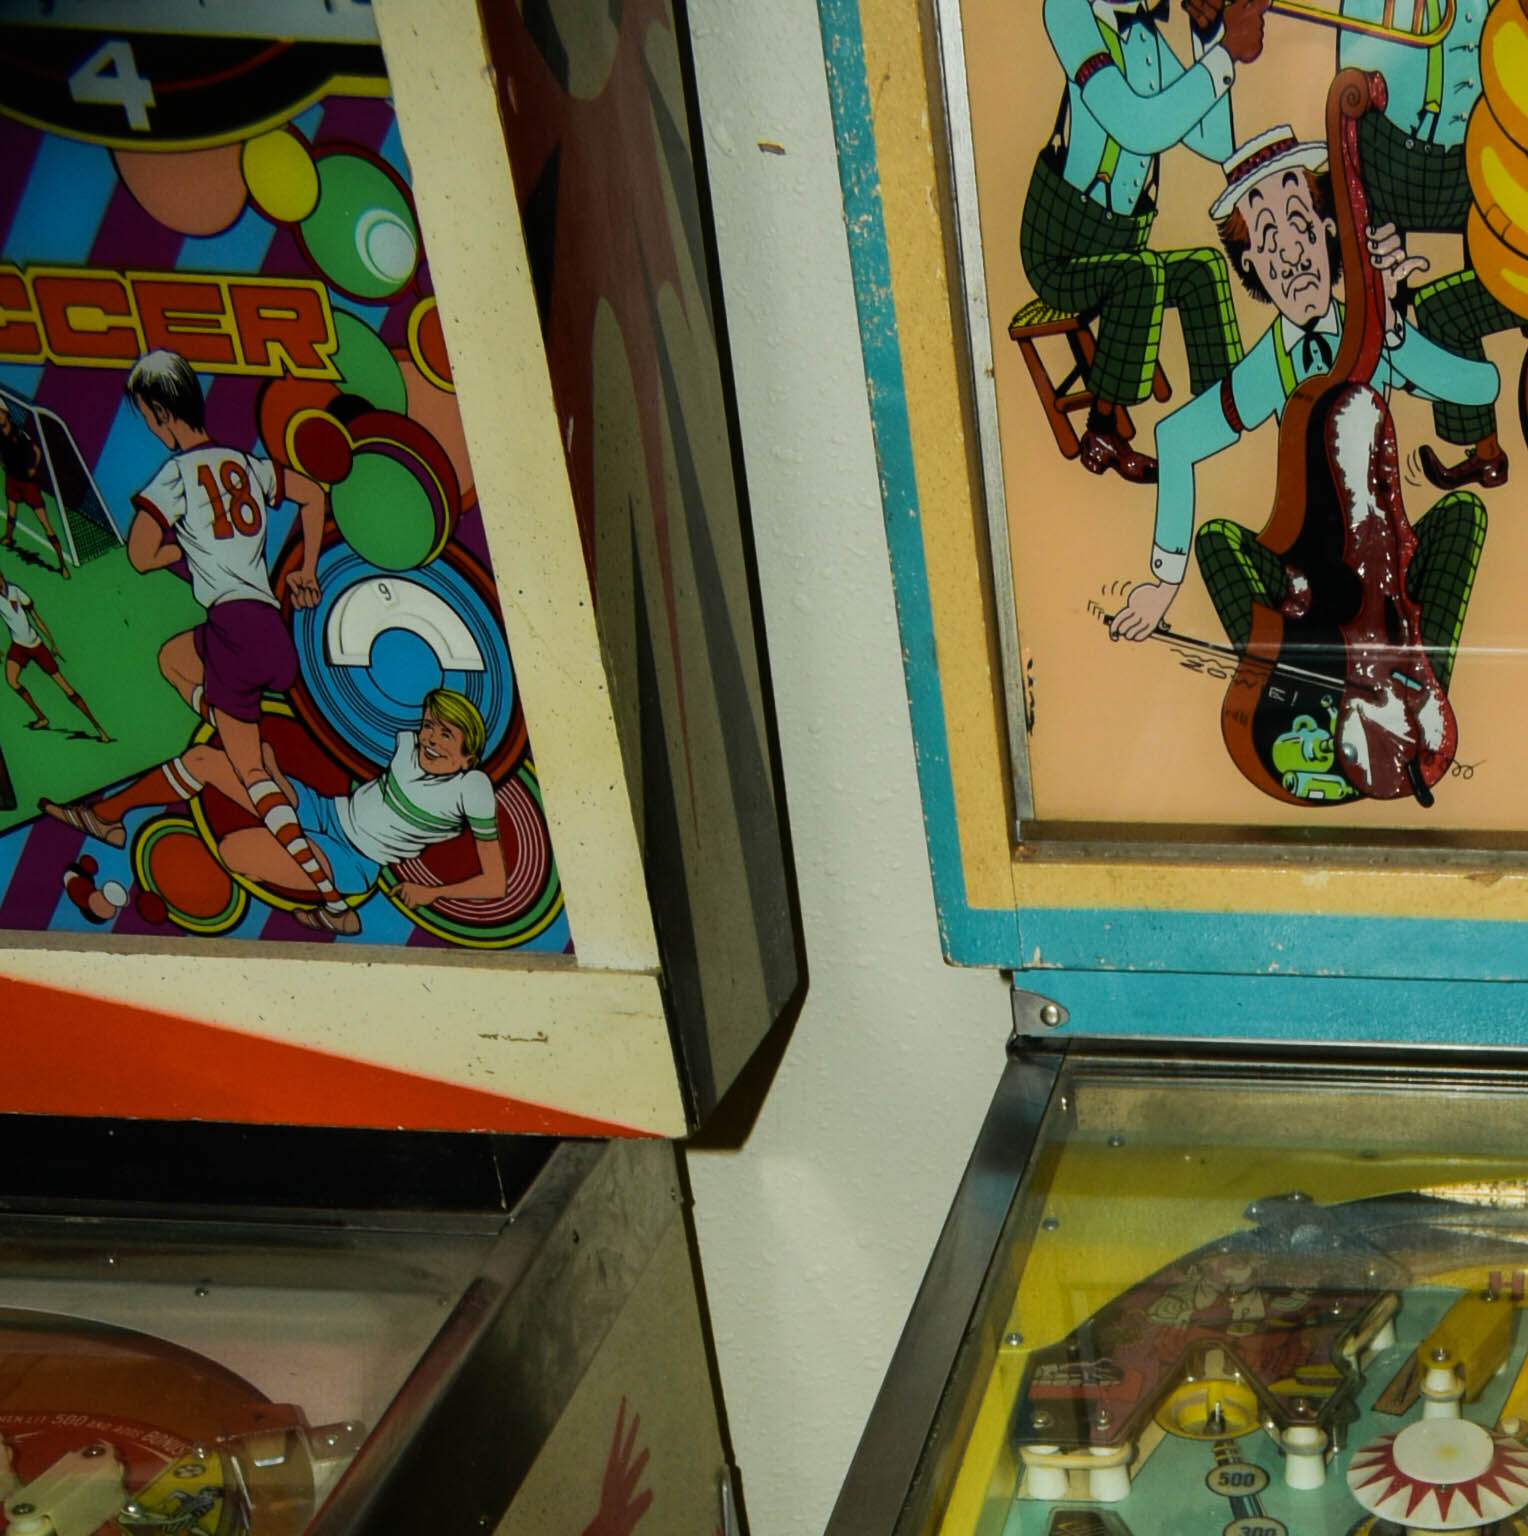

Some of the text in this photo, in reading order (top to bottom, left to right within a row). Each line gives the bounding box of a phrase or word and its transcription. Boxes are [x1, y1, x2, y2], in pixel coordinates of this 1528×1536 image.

[68, 38, 156, 132] 4
[195, 461, 259, 541] 18
[1218, 1471, 1256, 1489] 500
